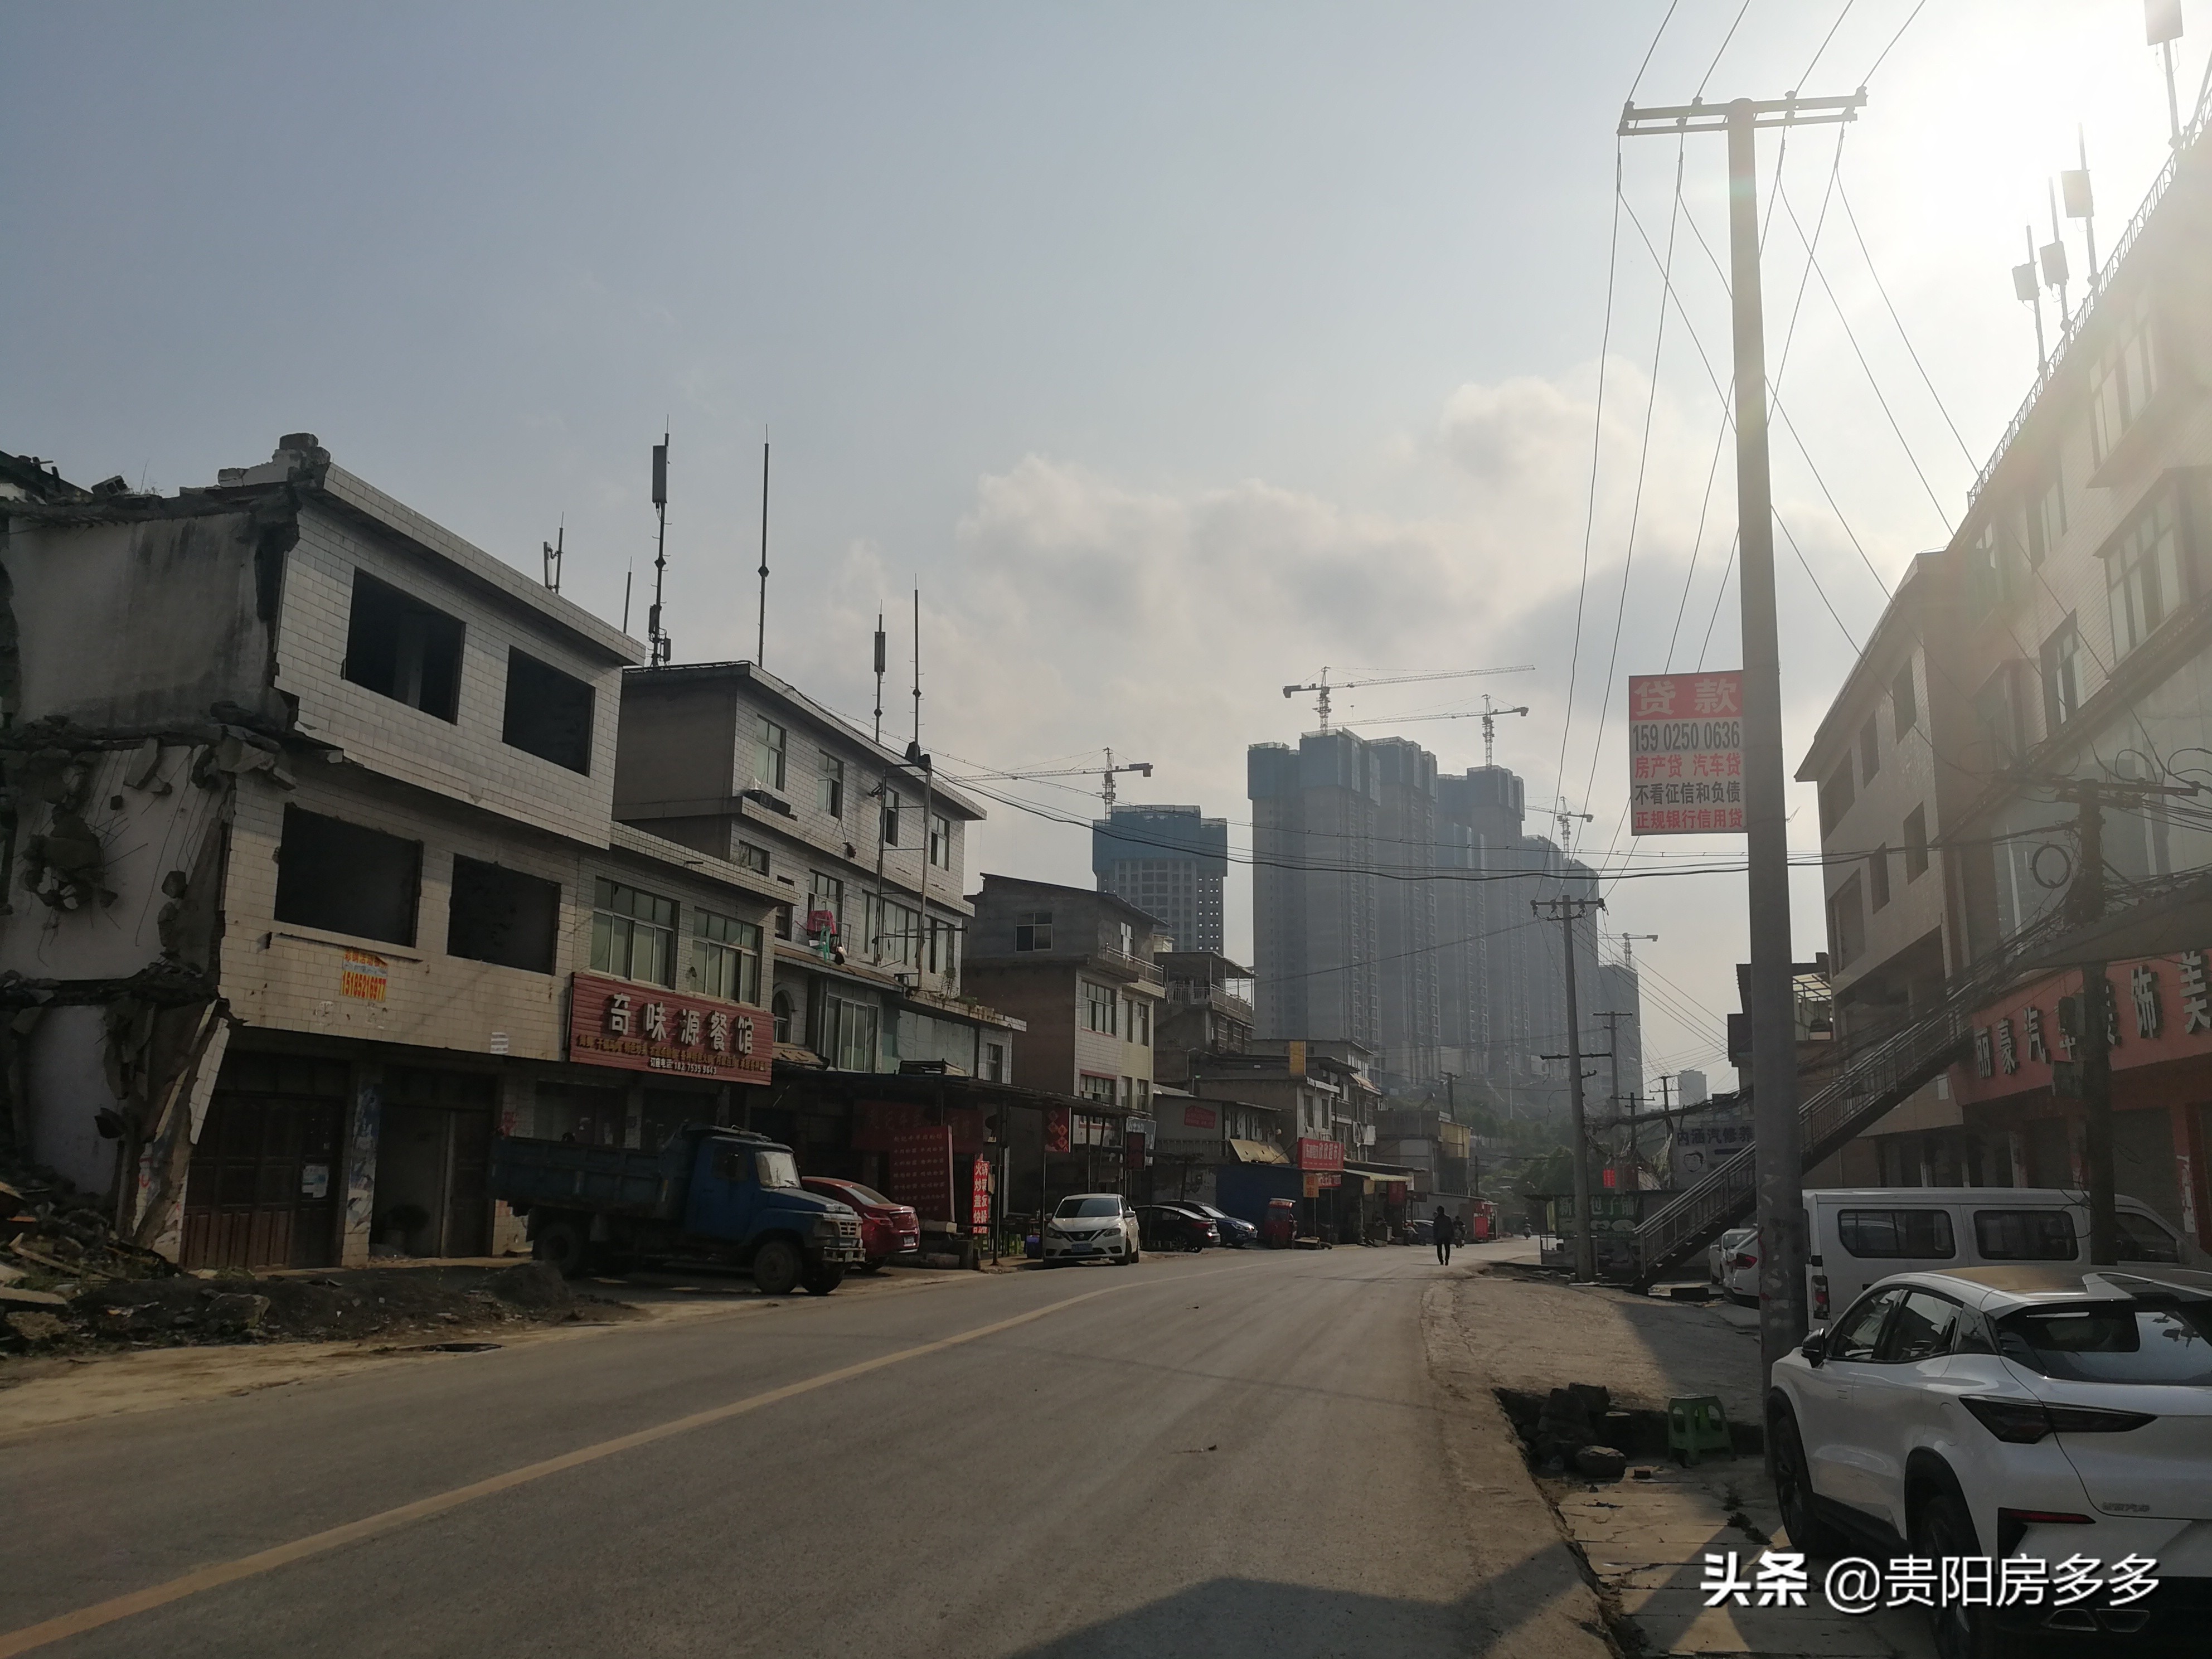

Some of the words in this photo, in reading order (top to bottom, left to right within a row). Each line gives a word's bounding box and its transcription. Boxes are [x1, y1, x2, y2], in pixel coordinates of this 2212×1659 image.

[1634, 678, 1738, 716] 贷款
[1633, 724, 1658, 751] 159
[1663, 722, 1699, 750] 0250
[1704, 721, 1740, 749] 0636
[1634, 755, 1682, 779] 房产贷
[1692, 753, 1741, 777] 汽车贷
[1635, 780, 1740, 805] 不看征信和负债
[1636, 808, 1742, 829] 正规银行信用贷
[611, 993, 754, 1054] 奇味源餐馆
[674, 1062, 685, 1071] 182
[1306, 1177, 1314, 1197] 超市
